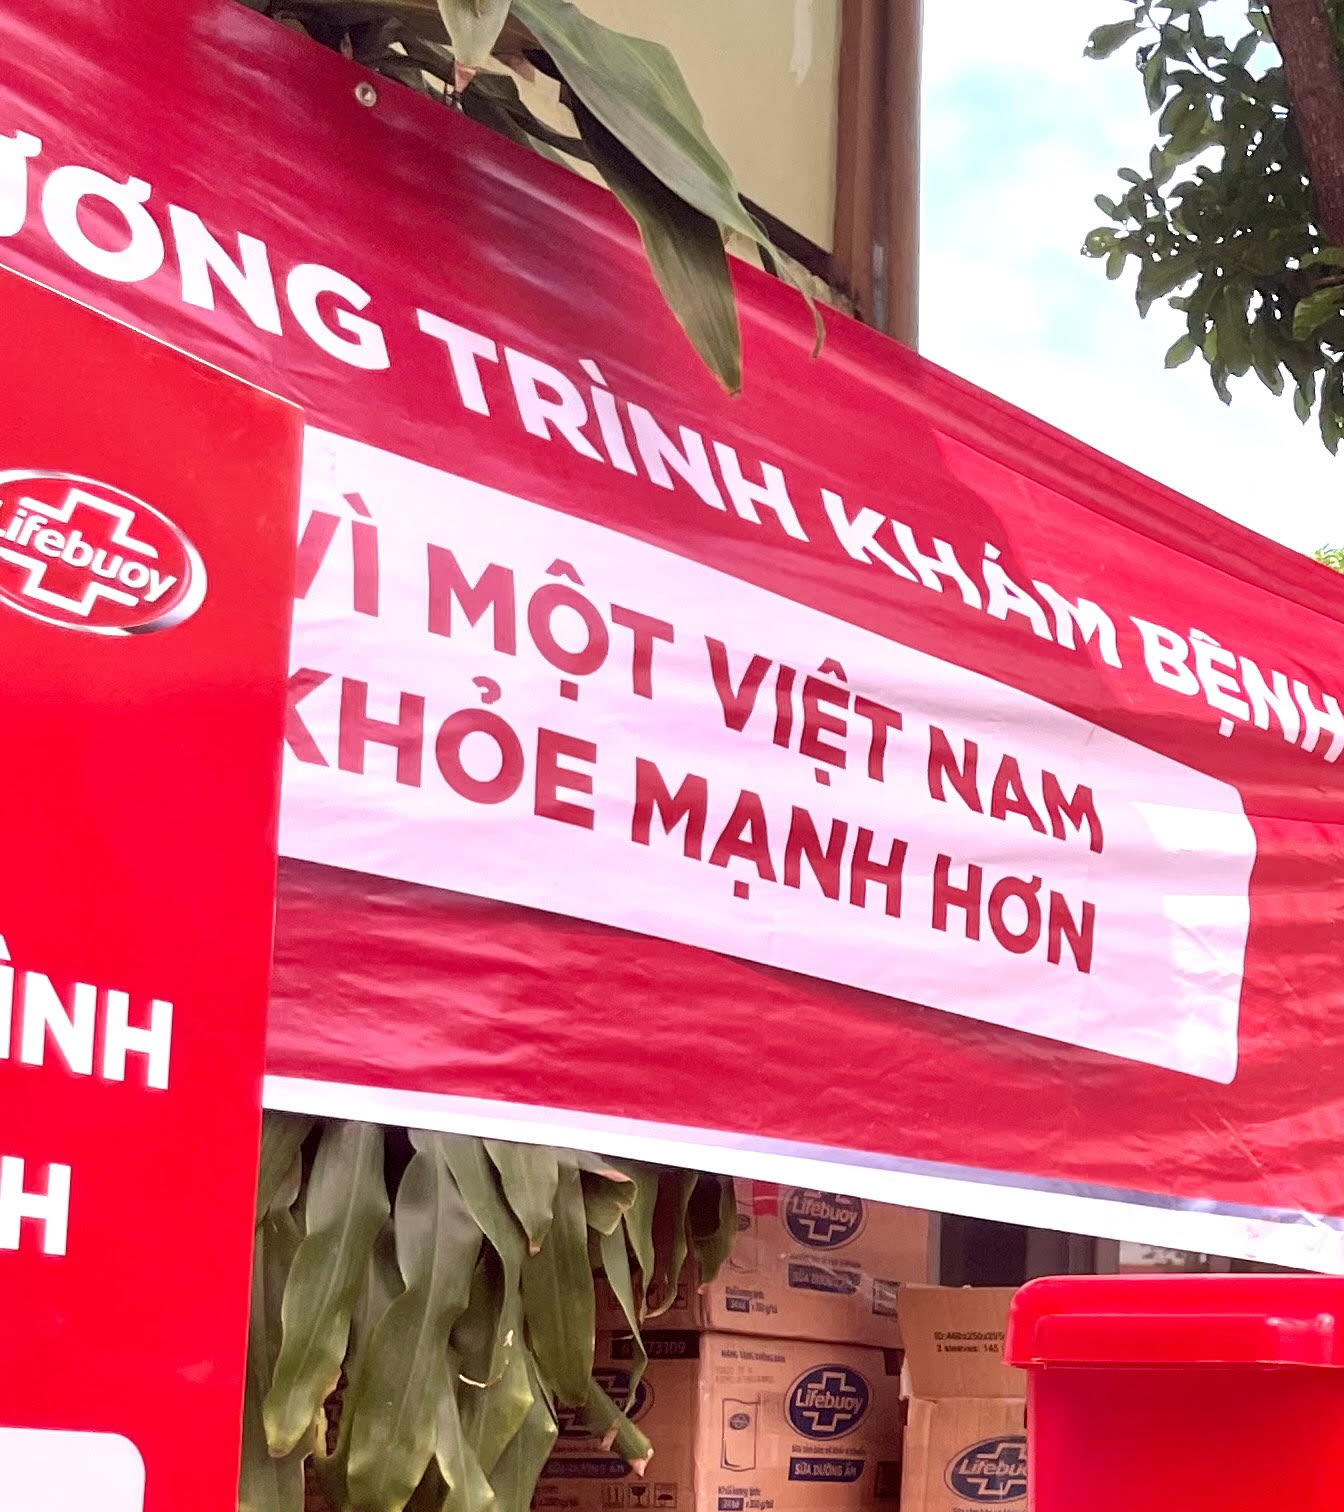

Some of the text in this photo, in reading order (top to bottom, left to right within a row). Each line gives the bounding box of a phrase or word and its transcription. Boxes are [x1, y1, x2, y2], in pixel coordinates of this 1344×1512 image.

[0, 508, 178, 603] ifebuoy
[416, 308, 810, 543] TRÌNH
[820, 488, 1122, 668] KHÁM
[426, 542, 674, 702] MỘT
[704, 635, 904, 787] VIỆT
[926, 728, 1104, 854] NAM
[282, 666, 1096, 975] KHỎE MẠNH HƠN
[791, 1197, 859, 1227] Lifebuoy
[795, 1388, 864, 1415] Lifebuoy
